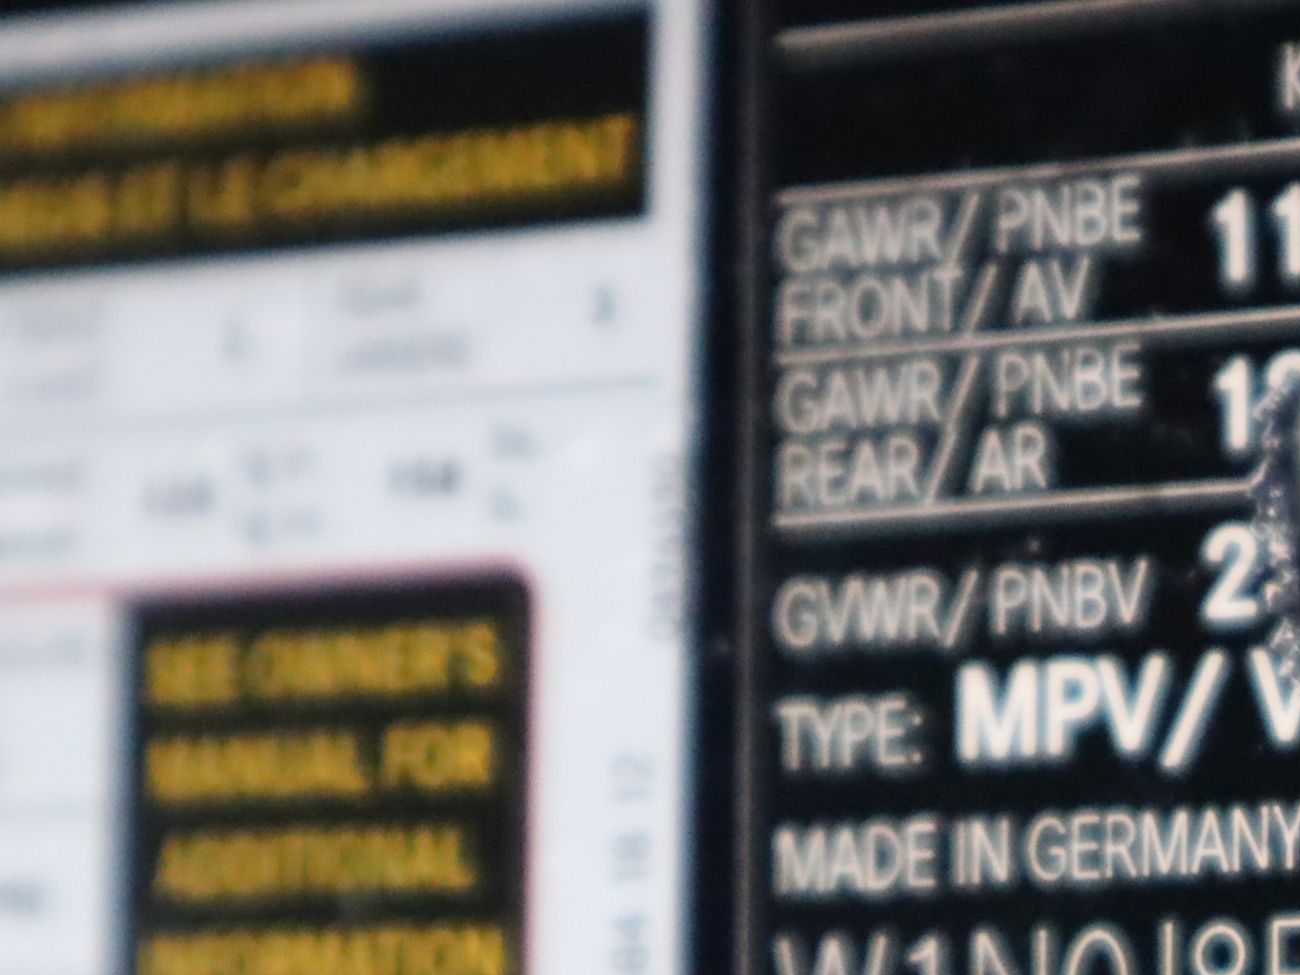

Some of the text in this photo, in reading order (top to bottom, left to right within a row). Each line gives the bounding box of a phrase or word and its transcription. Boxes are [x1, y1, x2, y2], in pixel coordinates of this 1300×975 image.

[776, 173, 1143, 272] GAWR/ PNBE
[779, 257, 1091, 347] FRONT/ AV
[776, 343, 1143, 436] GAWR/ PNBE
[777, 425, 1048, 510] REAR/ AR
[776, 558, 1148, 650] GVWR/ PNBV
[381, 719, 494, 788] FOR
[779, 694, 924, 772] TYPE:
[957, 651, 1224, 772] MPV/
[775, 821, 937, 896] MADE
[953, 818, 1010, 885] IN
